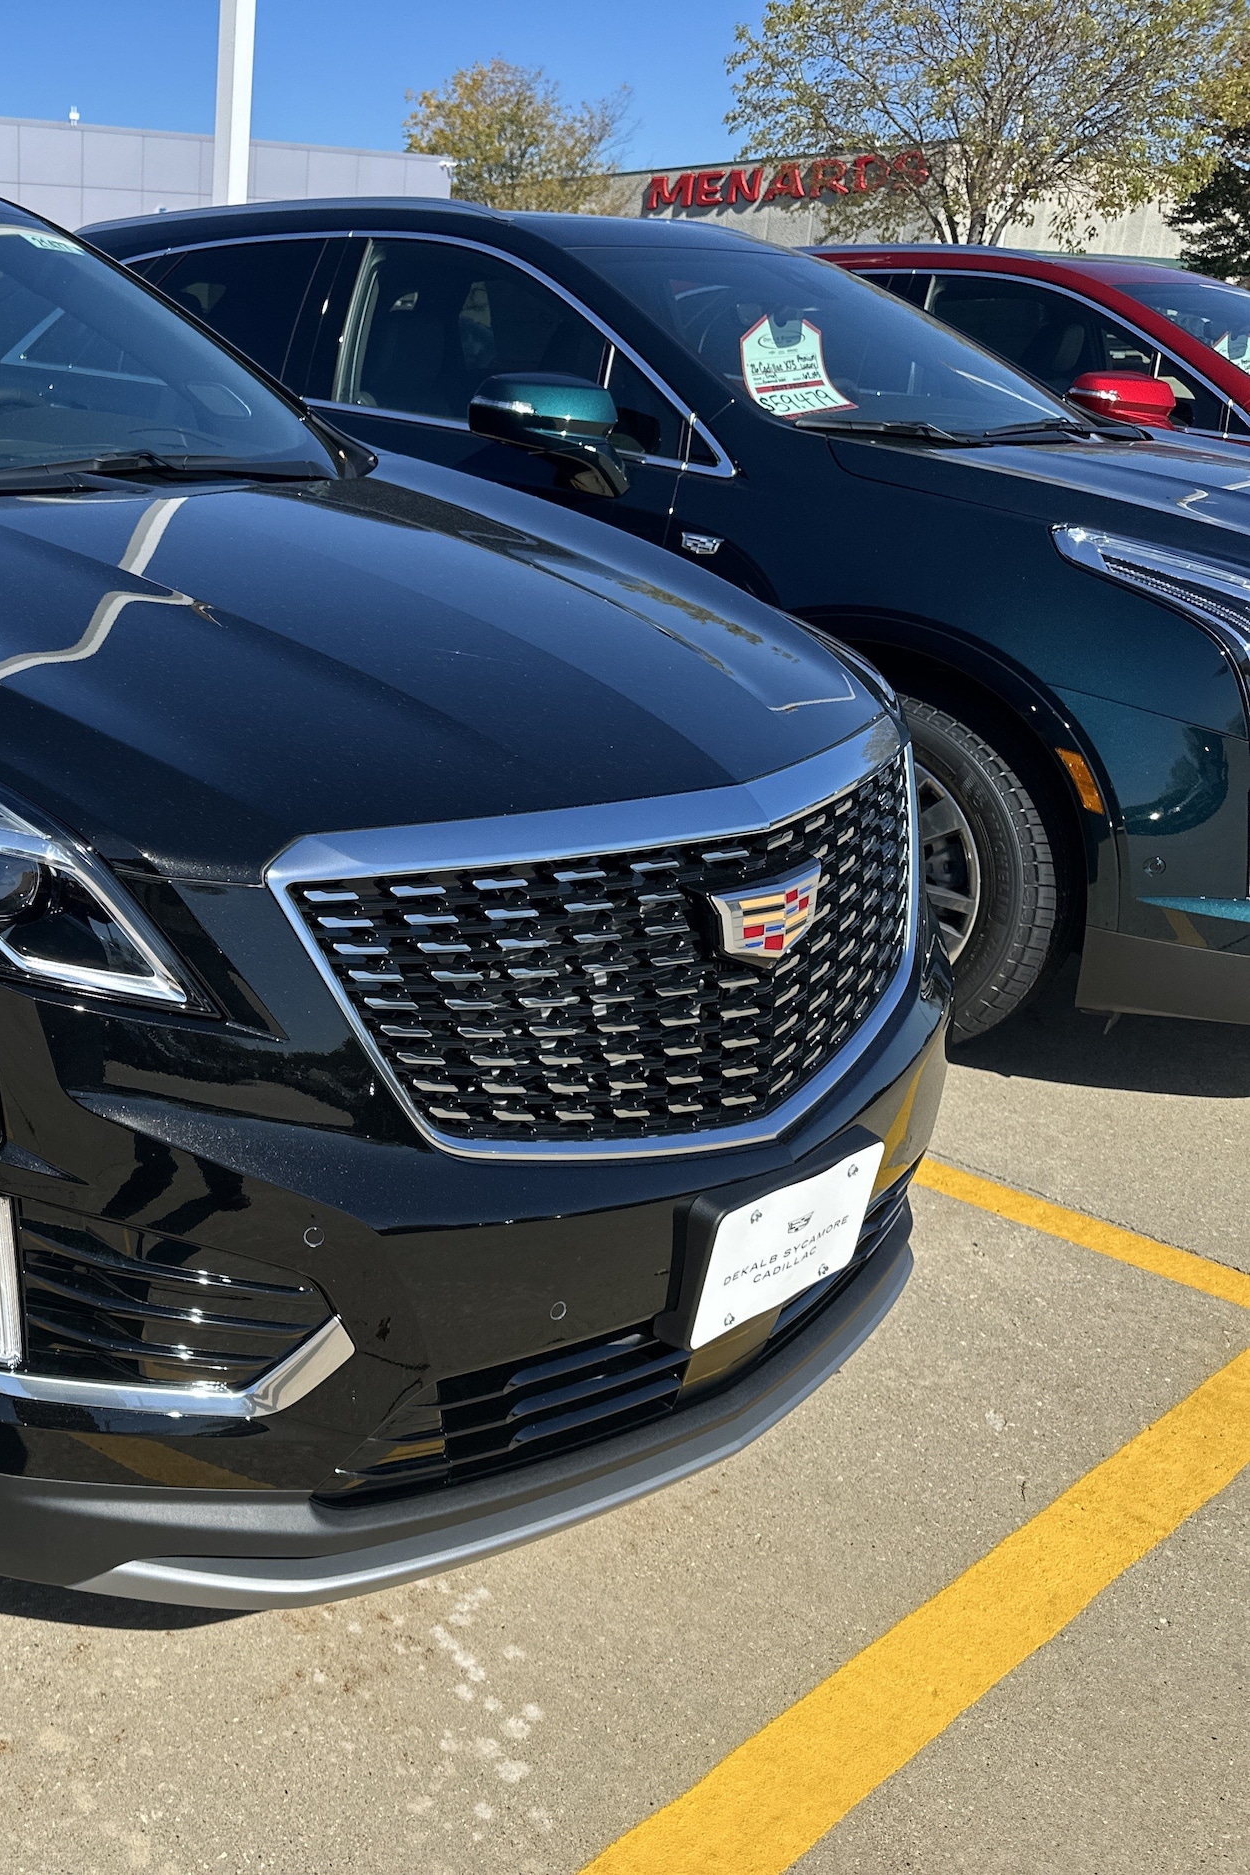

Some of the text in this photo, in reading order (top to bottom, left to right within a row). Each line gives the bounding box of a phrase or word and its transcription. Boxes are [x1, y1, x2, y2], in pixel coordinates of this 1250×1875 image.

[646, 150, 929, 210] MENARDS
[723, 1214, 850, 1286] DEKALB SYCAMORE
[752, 1246, 818, 1284] CADILLAC
